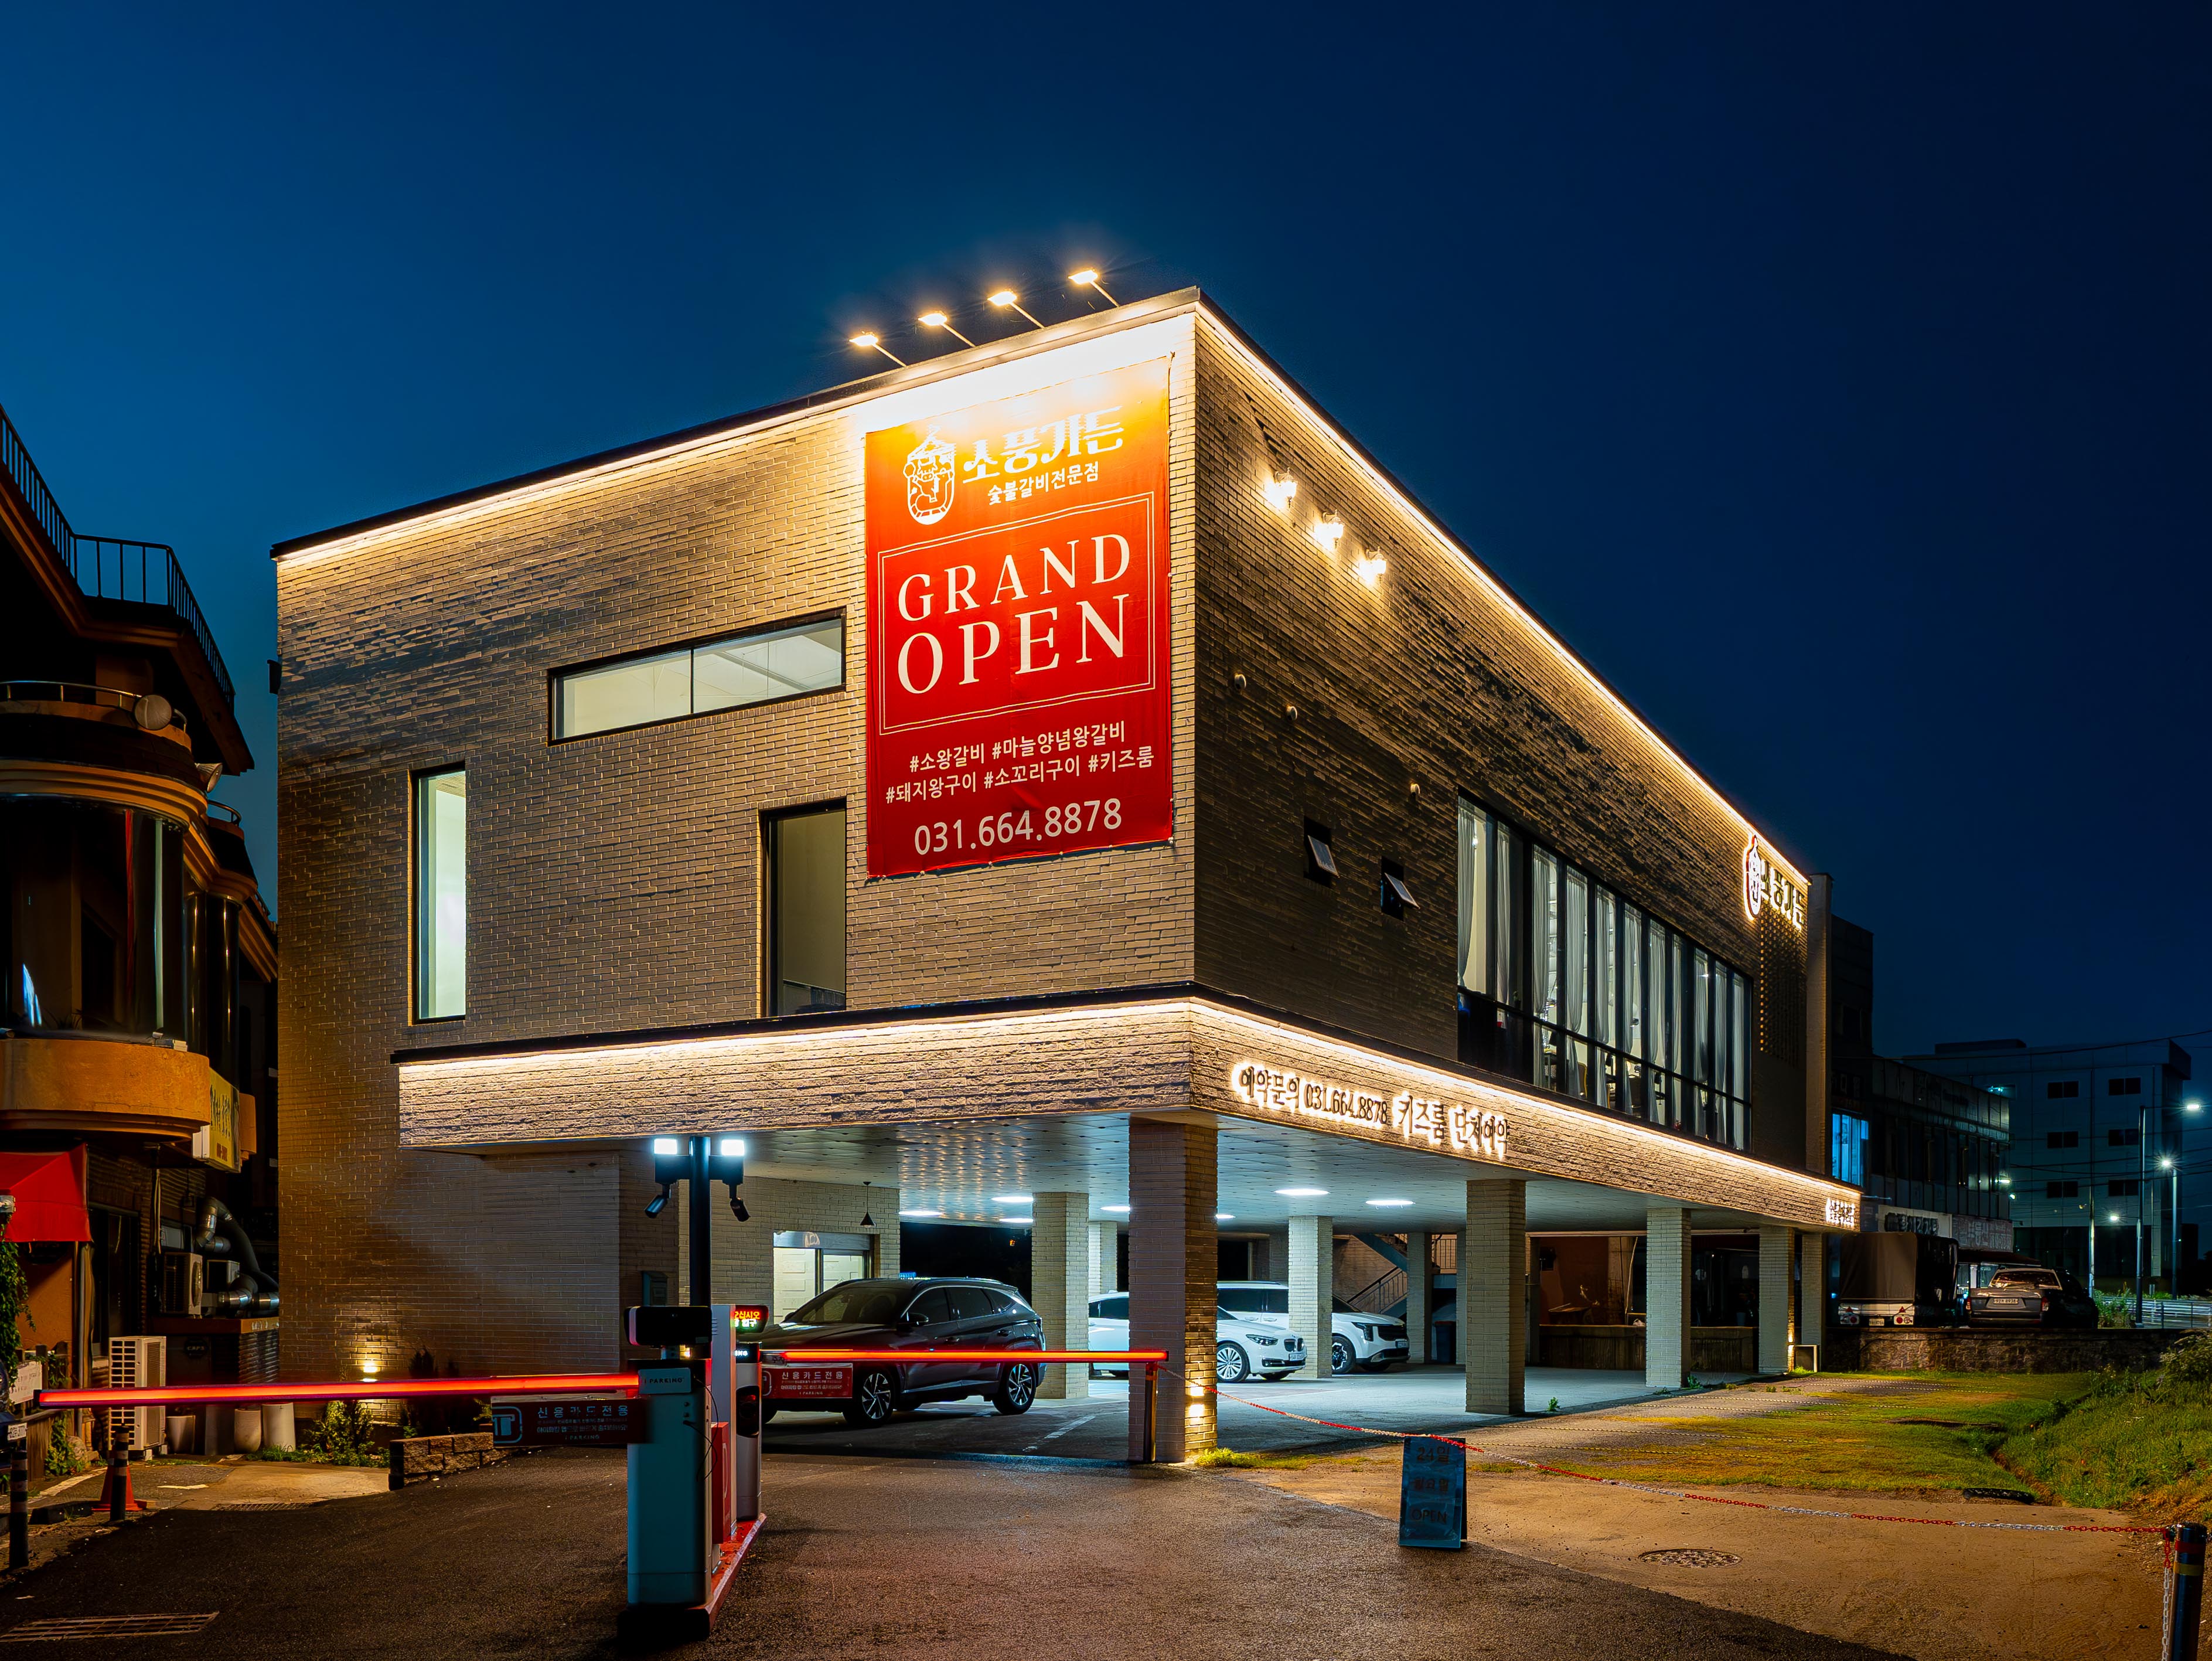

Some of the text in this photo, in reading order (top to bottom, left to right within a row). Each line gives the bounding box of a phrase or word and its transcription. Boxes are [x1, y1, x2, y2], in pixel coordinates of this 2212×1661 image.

[963, 405, 1124, 484] 소풍가든
[987, 461, 1099, 505] 숯불갈비전문점
[898, 533, 1130, 622] GRAND
[897, 594, 1130, 695] OPEN
[885, 746, 1154, 804] #돼지왕구이 #소꼬리구이 #키즈룸
[909, 720, 1125, 773] #소왕갈비 #마늘양념왕갈비
[914, 798, 1122, 855] 031.664.8878
[1238, 1066, 1510, 1153] 예약문의 031.664.8878 키즈룸 단체예약
[782, 1371, 843, 1380] 신용카드전용
[537, 1405, 629, 1418] 신용카드전용
